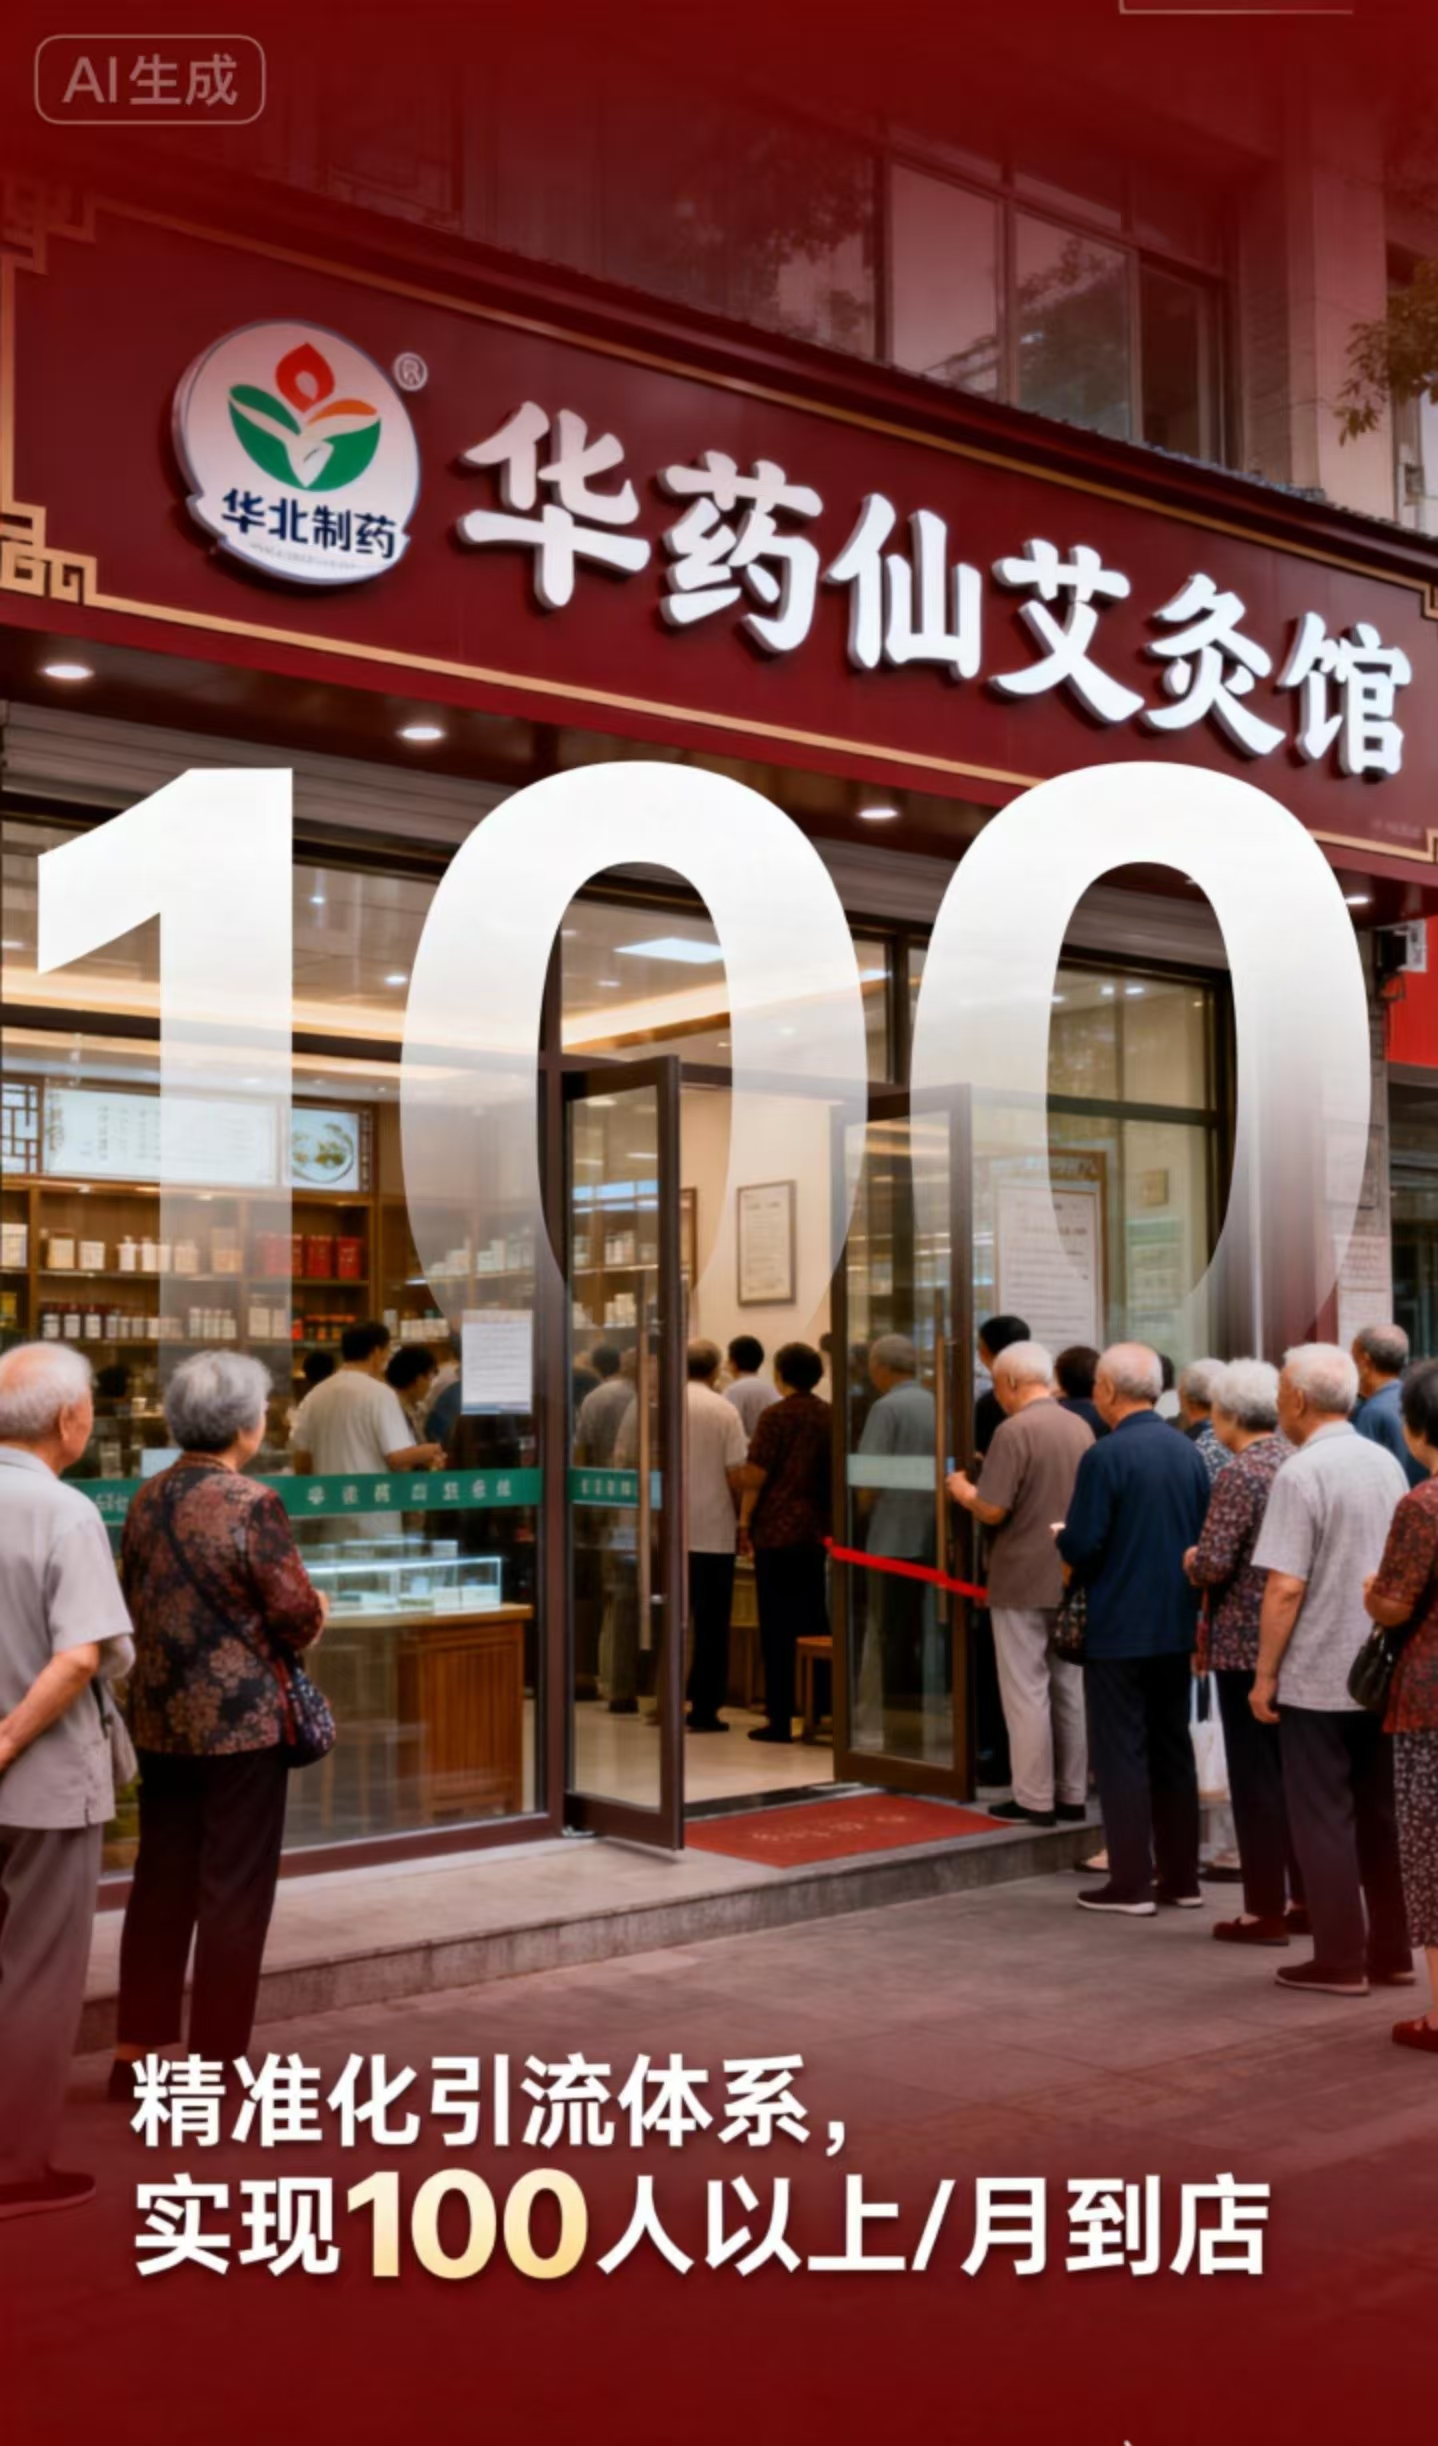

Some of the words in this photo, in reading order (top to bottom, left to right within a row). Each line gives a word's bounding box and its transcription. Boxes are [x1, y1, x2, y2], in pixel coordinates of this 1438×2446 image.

[221, 488, 397, 559] 华北制药
[458, 400, 1412, 776] 华药仙艾灸馆
